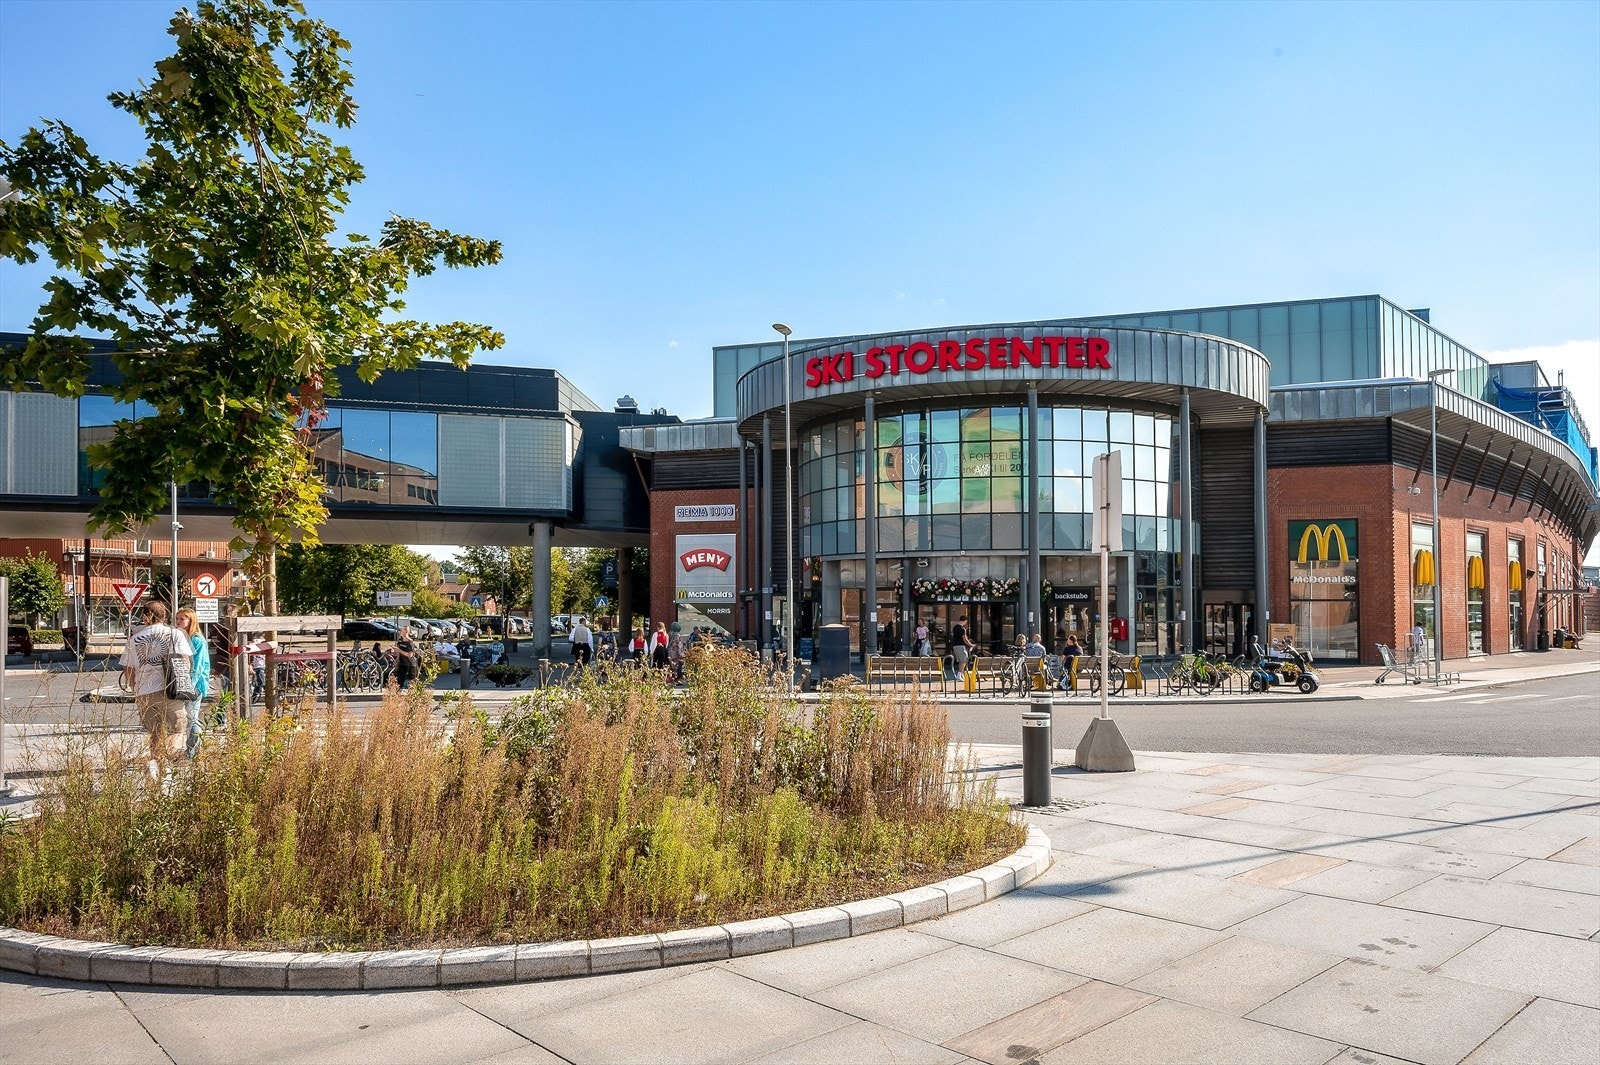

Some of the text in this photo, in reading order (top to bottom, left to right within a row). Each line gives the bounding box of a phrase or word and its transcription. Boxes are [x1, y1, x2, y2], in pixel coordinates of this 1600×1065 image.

[805, 336, 1112, 388] SKI STORSENTER
[677, 506, 734, 518] REMA 1000
[685, 552, 725, 566] MENY
[1293, 575, 1356, 584] McDonald's
[688, 590, 733, 599] McDonald's
